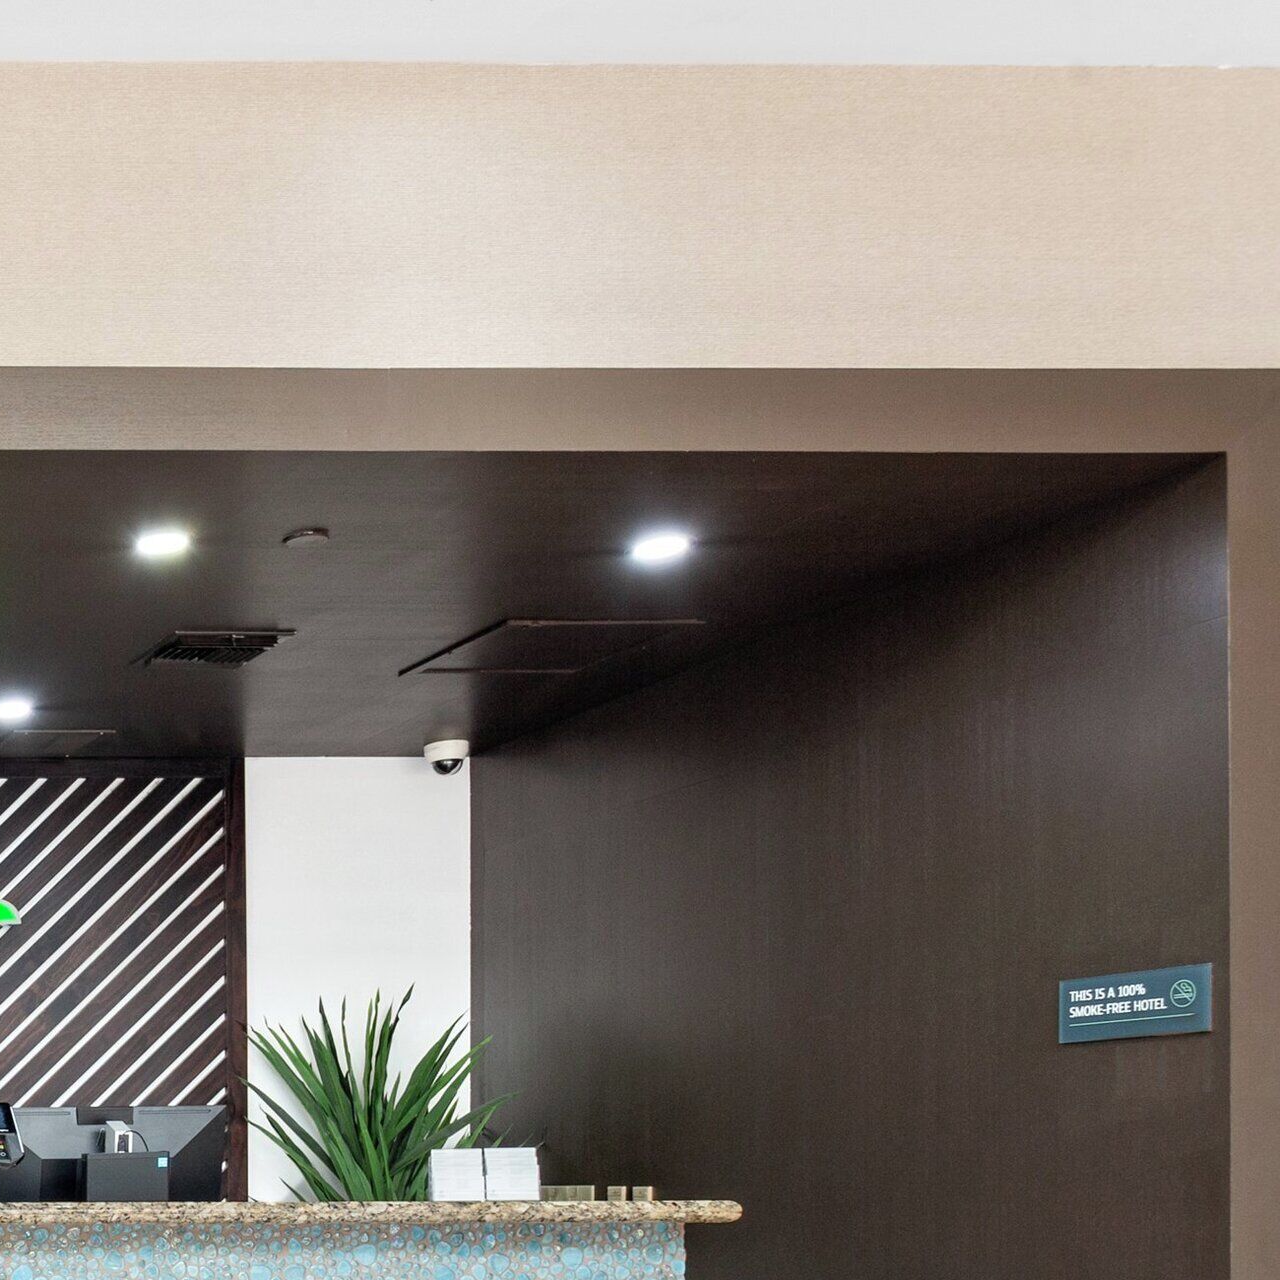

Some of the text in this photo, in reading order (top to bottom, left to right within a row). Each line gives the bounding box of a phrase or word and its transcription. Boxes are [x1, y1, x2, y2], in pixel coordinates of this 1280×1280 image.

[1069, 983, 1146, 1002] THIS IS A 100%
[1069, 997, 1168, 1018] SMOKE-FREE HOTEL
